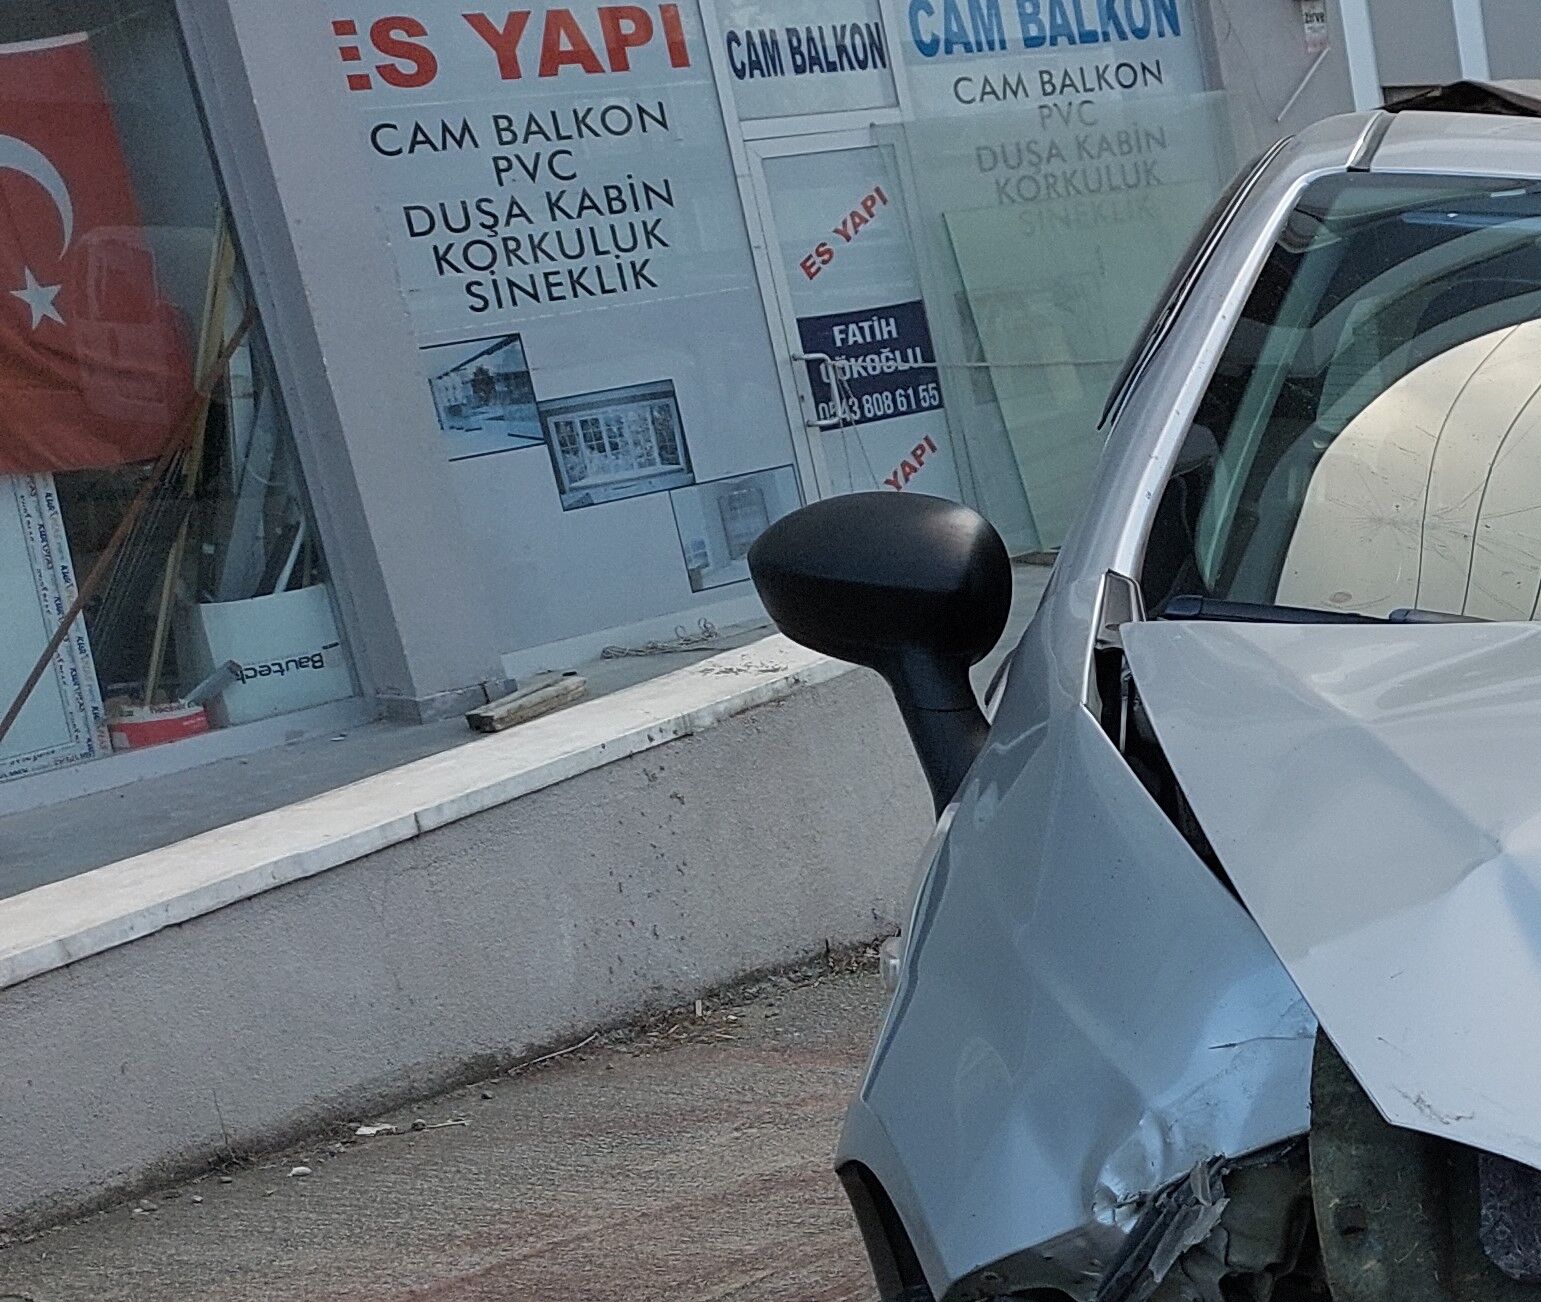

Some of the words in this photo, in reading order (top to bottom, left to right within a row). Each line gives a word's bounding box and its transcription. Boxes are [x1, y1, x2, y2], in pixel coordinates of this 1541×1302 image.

[461, 3, 691, 81] YAPI
[726, 28, 785, 81] CAM
[785, 20, 889, 76] BALKON
[908, 0, 1008, 58] CAM
[1017, 0, 1182, 50] BALKON
[953, 72, 1029, 105] CAM
[1038, 59, 1164, 98] BALKON
[369, 117, 480, 157] CAM
[491, 101, 670, 147] BALKON
[1037, 99, 1099, 131] PVC
[491, 150, 578, 187] PVC
[975, 138, 1067, 175] DUŞA
[1075, 122, 1168, 162] KABİN
[402, 194, 535, 238] DUŞA
[545, 174, 675, 223] KABİN
[994, 159, 1165, 206] KORKULUK
[431, 217, 670, 277] KORKULUK
[799, 241, 834, 281] ES
[832, 185, 889, 243] YAPI
[464, 253, 659, 315] SİNEKLİK
[832, 315, 899, 348] FATİH
[862, 391, 894, 418] 808
[895, 386, 916, 412] 61
[918, 382, 940, 408] 55
[883, 434, 938, 492] YAPI
[235, 652, 324, 685] Bautech
